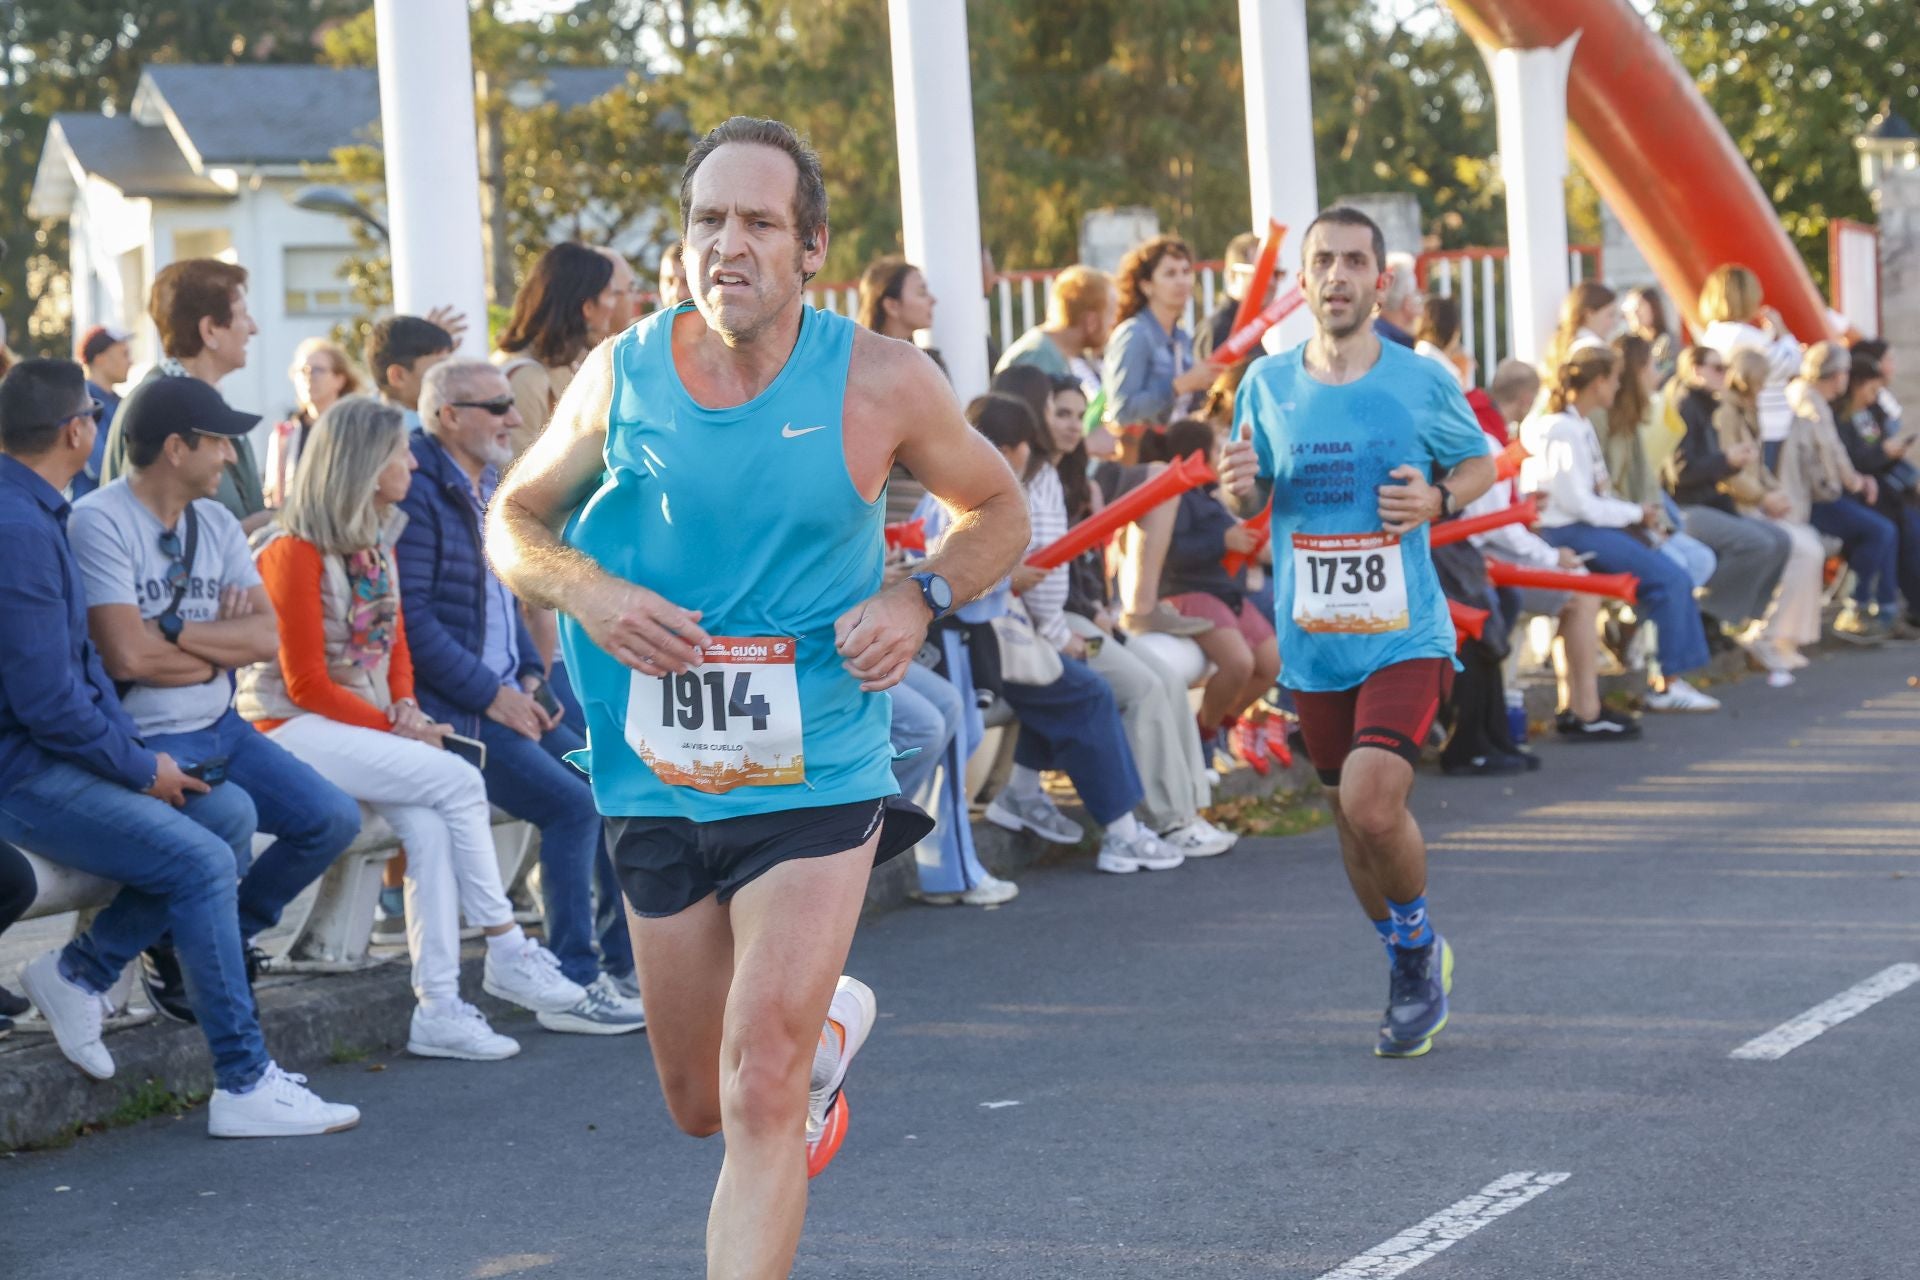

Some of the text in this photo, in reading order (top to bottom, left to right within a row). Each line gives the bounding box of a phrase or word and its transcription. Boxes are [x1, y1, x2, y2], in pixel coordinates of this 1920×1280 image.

[1312, 442, 1352, 454] MBA
[1304, 460, 1354, 474] media
[1307, 554, 1386, 594] 1738
[731, 643, 768, 656] GIJÓN
[658, 671, 771, 731] 1914
[709, 744, 744, 752] CUELLO
